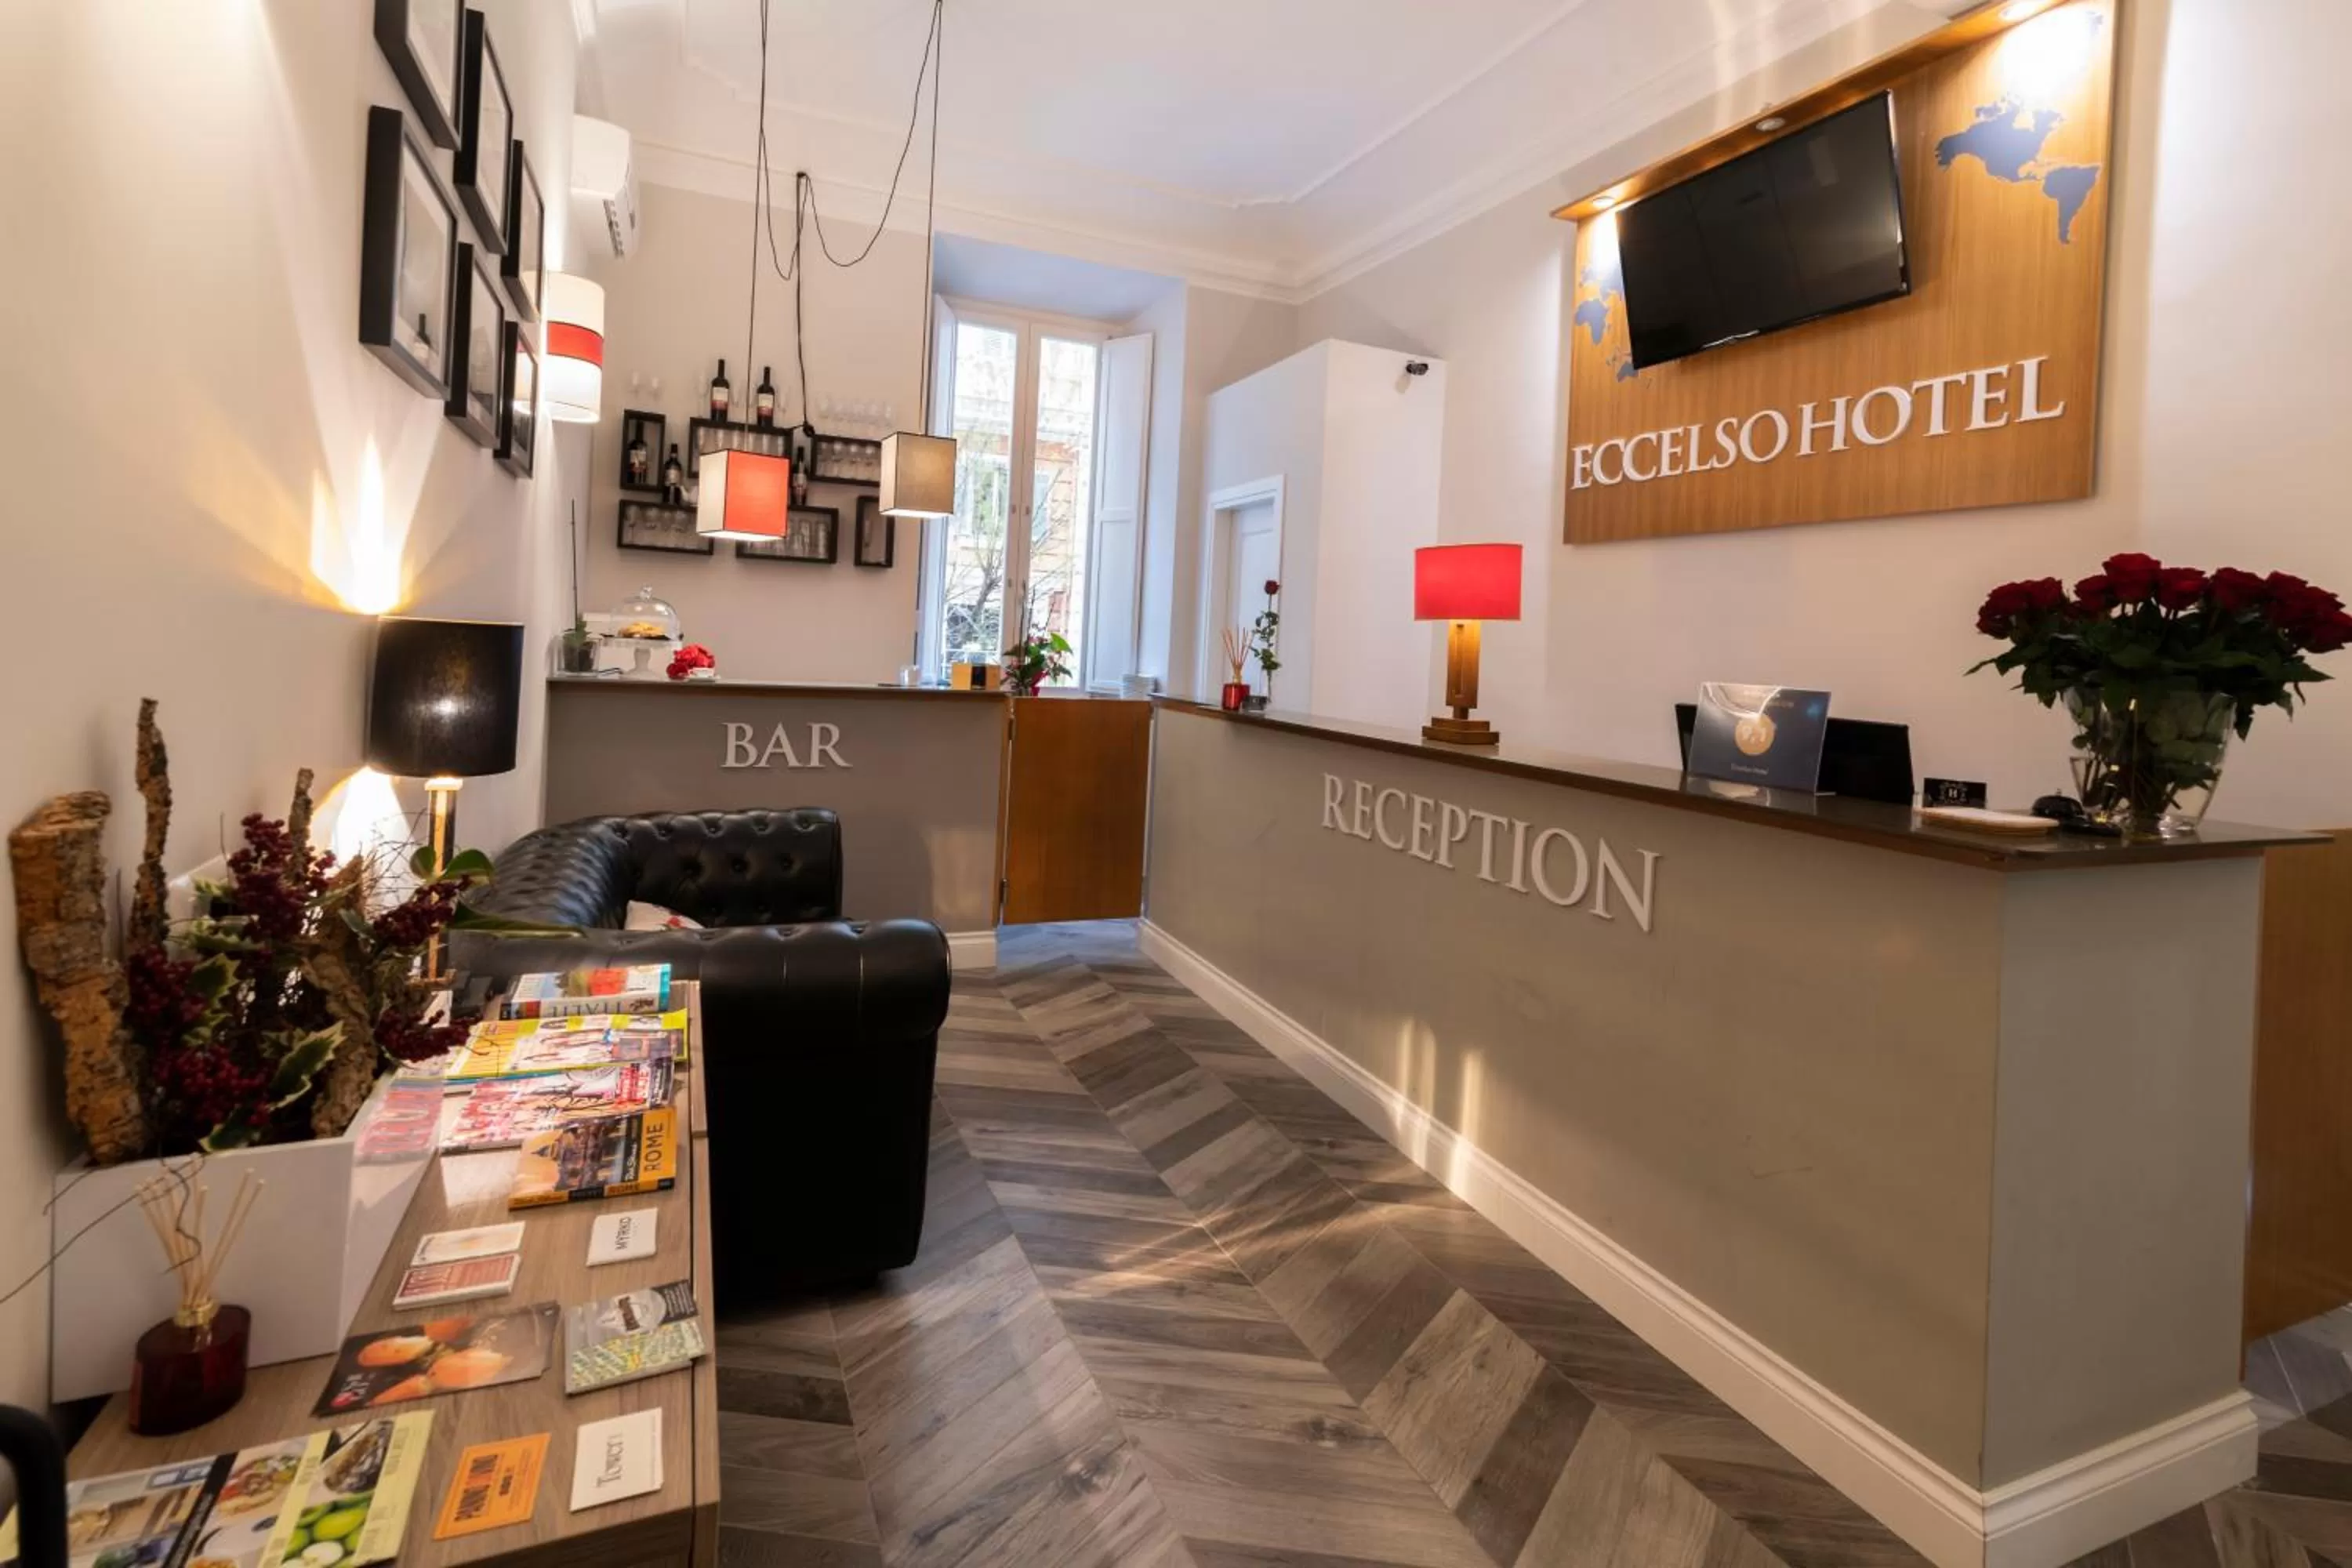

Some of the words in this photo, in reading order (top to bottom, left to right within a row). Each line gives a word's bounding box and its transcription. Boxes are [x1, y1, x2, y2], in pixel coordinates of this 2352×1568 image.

[1570, 409, 1789, 491] ECCELSO
[1795, 355, 2065, 457] HOTEL
[720, 721, 854, 768] BAR
[1322, 771, 1663, 933] RECEPTION
[644, 1122, 664, 1172] ROME
